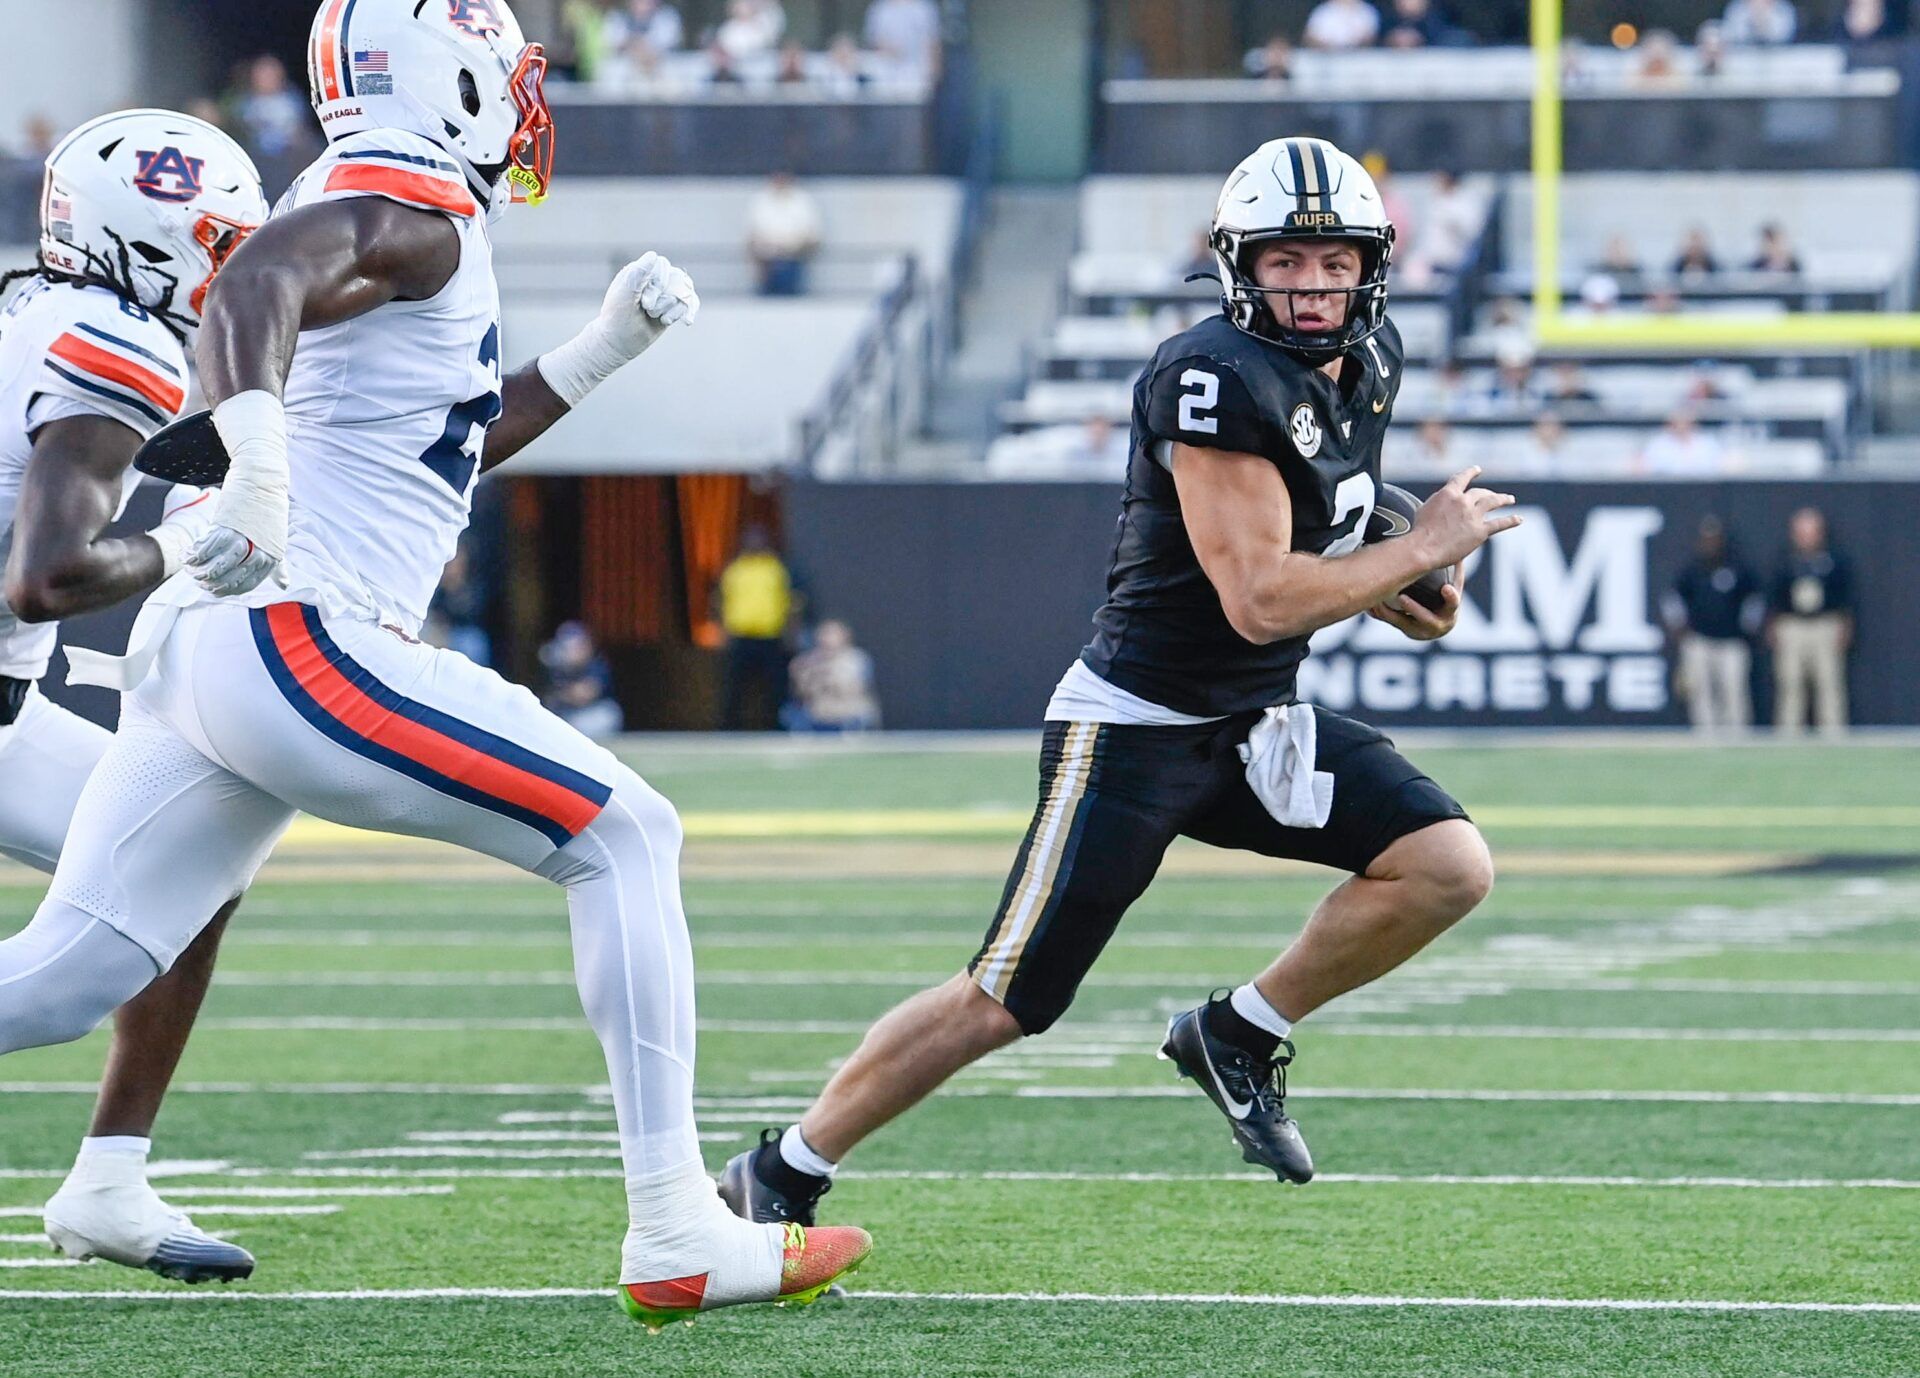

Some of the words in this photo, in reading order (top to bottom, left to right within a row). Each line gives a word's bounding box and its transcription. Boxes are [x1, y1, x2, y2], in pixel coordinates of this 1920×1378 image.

[334, 107, 362, 119] EAGLE
[513, 170, 539, 190] BATT
[1293, 213, 1335, 226] VUFB
[1366, 336, 1390, 379] C
[1178, 368, 1220, 434] 2
[1320, 471, 1376, 559] 2
[1297, 654, 1669, 712] NCRETE
